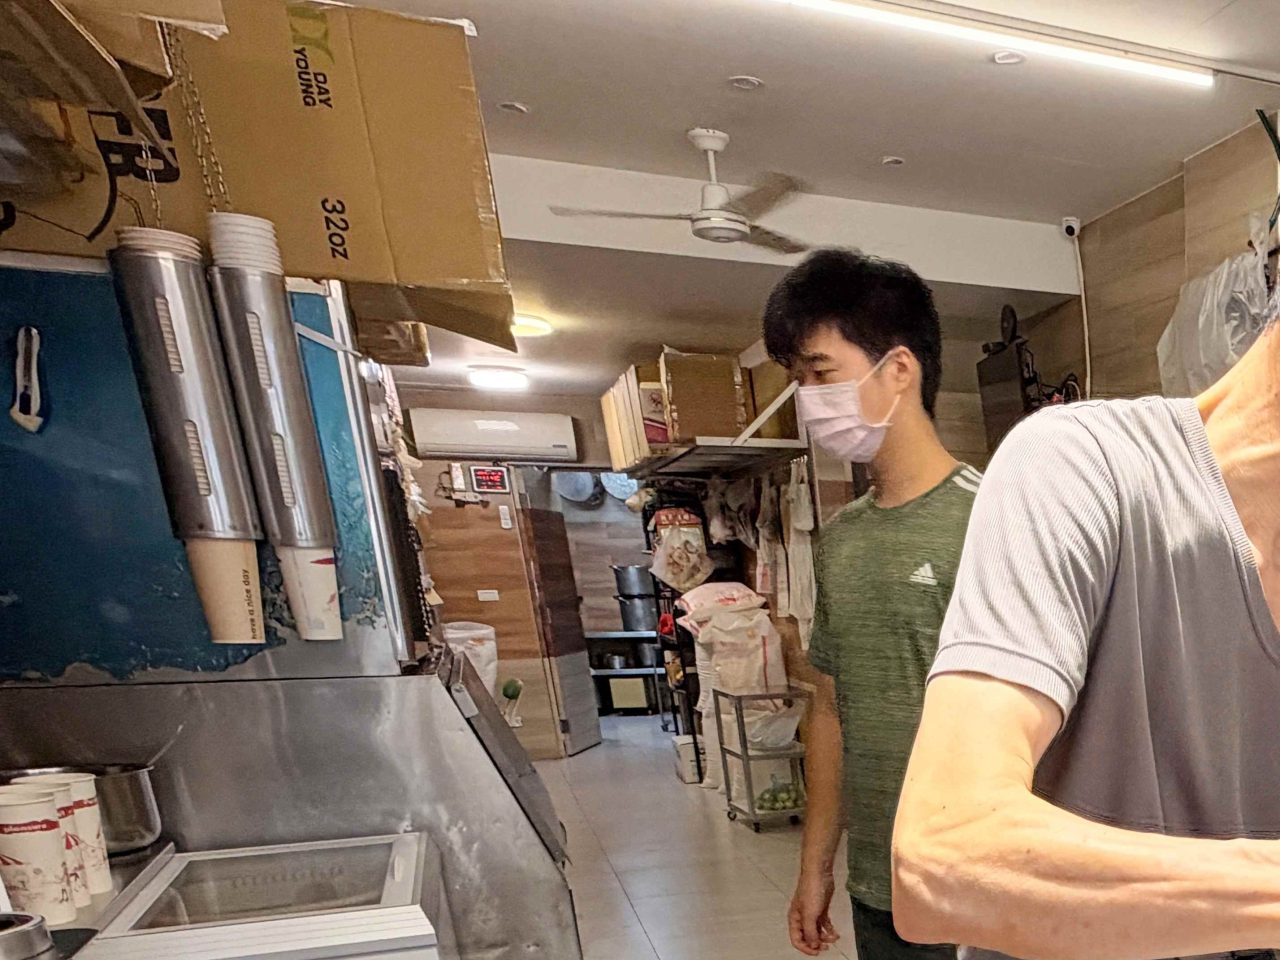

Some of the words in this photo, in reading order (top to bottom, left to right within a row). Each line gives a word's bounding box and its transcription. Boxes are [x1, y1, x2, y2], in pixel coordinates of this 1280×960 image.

[293, 47, 316, 106] YOUNG
[313, 72, 333, 108] DAY
[321, 198, 349, 260] 32oz
[242, 569, 250, 586] day
[244, 588, 254, 607] nice
